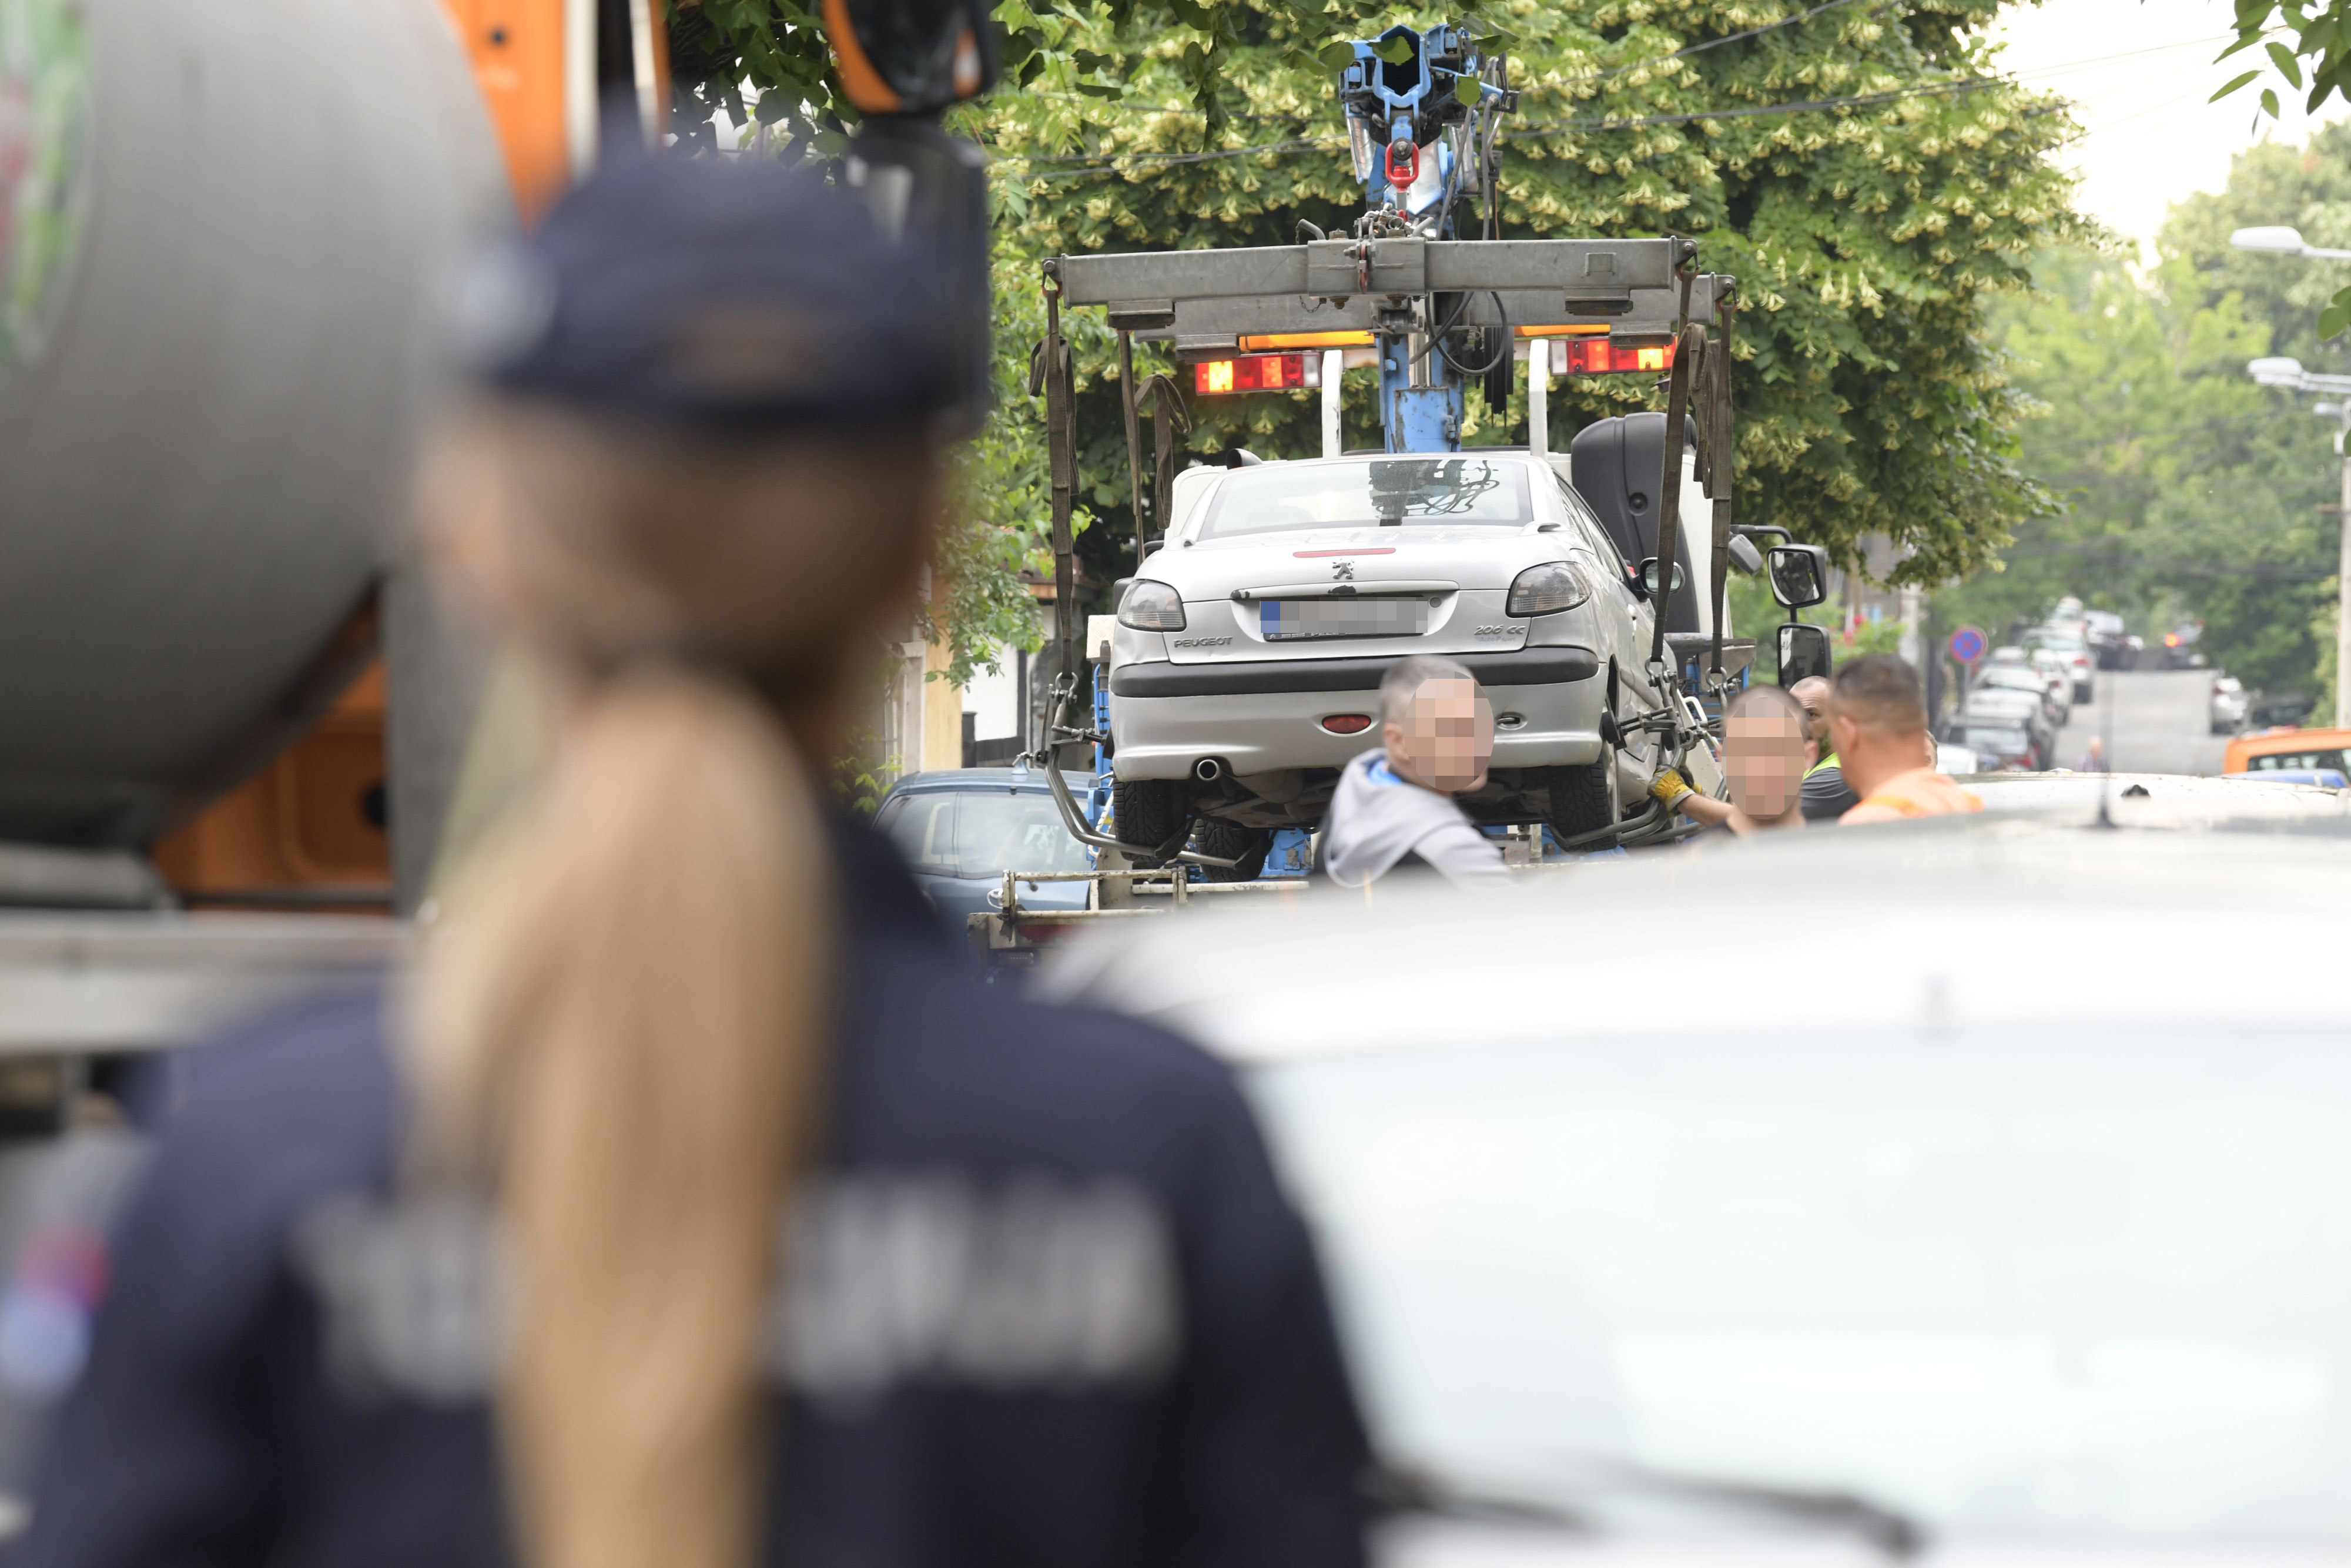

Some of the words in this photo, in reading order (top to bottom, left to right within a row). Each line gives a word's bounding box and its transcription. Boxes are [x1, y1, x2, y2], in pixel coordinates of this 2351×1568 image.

[1474, 624, 1503, 635] 206
[1507, 625, 1526, 634] CC
[1174, 636, 1233, 648] PEUGEOT
